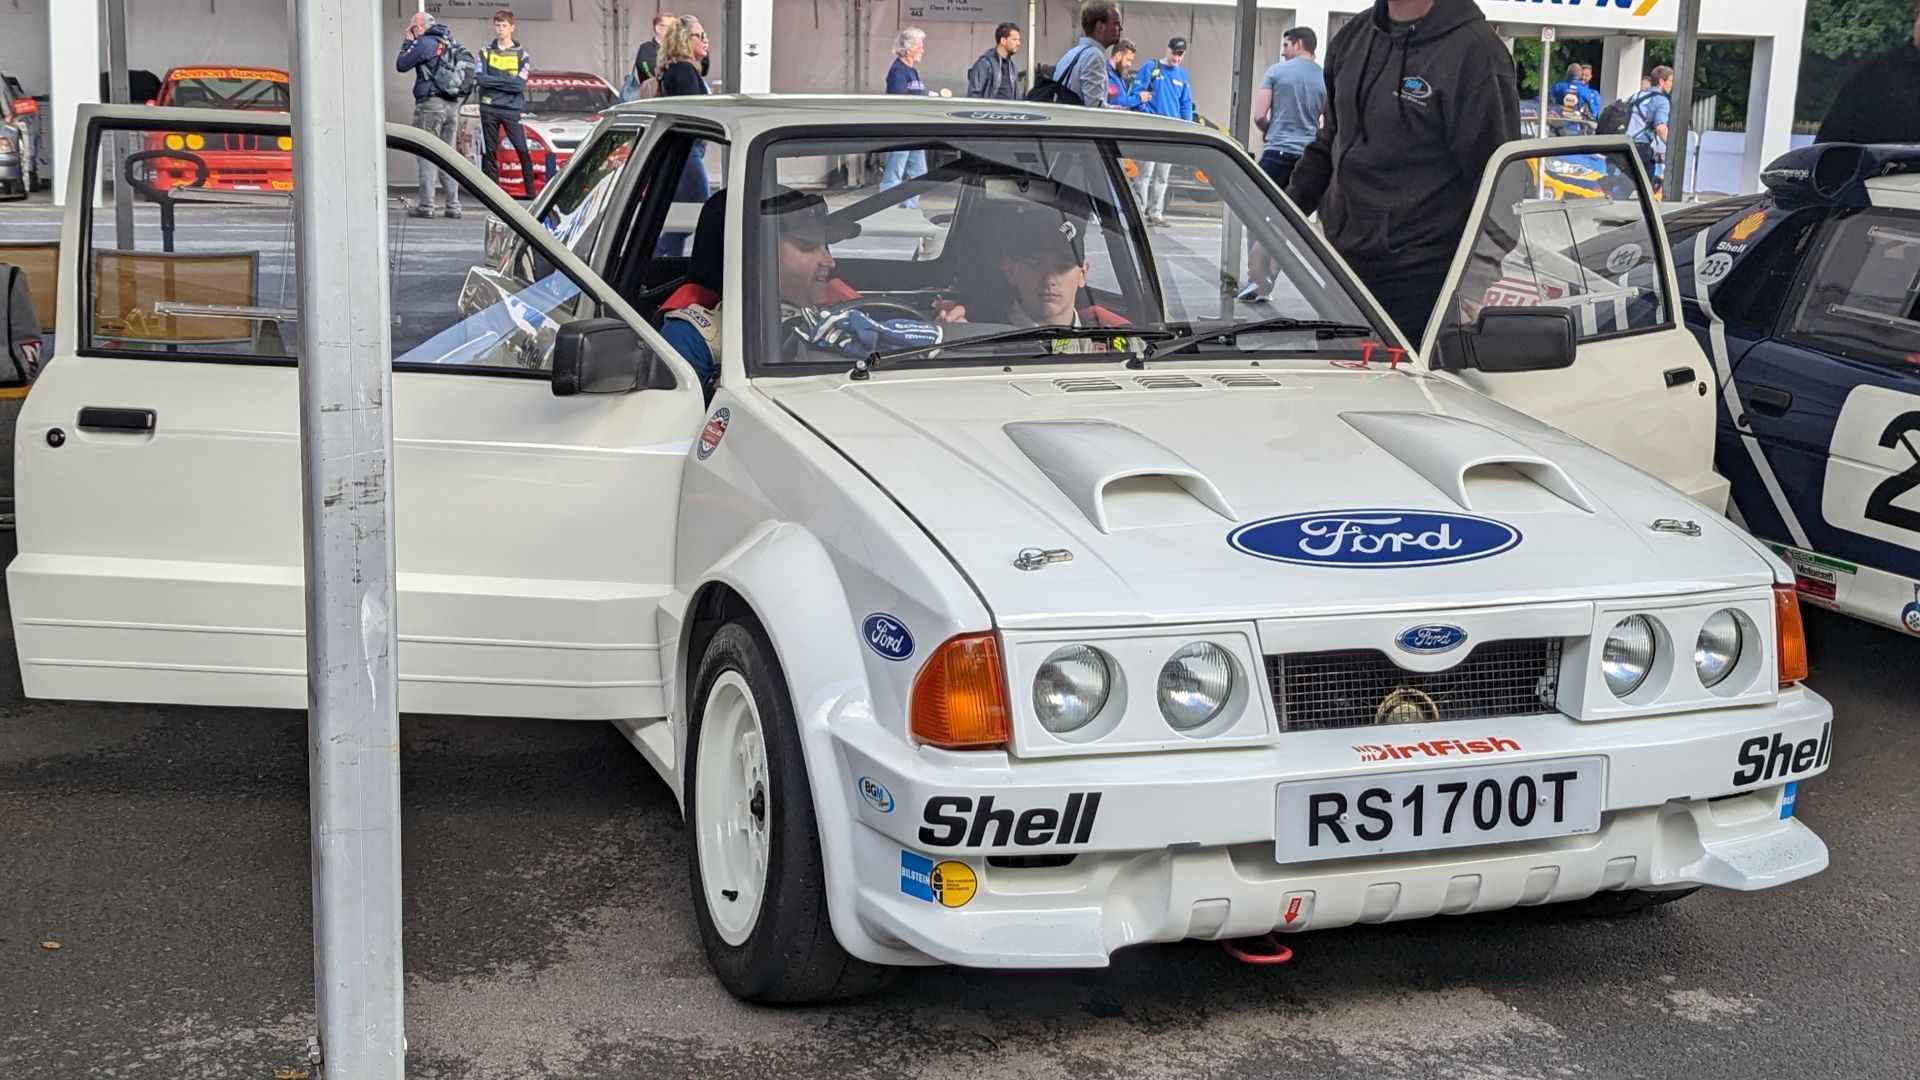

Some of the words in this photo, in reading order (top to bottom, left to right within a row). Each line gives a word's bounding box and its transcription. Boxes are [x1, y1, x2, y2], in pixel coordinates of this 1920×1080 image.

[172, 69, 226, 80] demon
[525, 79, 608, 88] UXHALL
[970, 111, 1030, 121] Ford
[1716, 241, 1747, 253] Shell
[1701, 259, 1729, 277] 235
[1298, 517, 1463, 556] Ford
[1796, 563, 1834, 582] Motorcraft
[871, 618, 904, 653] Ford
[1413, 627, 1452, 646] Ford
[1352, 736, 1522, 762] DirtFish
[1732, 720, 1832, 787] Shell
[864, 779, 884, 801] BGM
[1307, 770, 1578, 848] RS1700T
[918, 792, 1103, 848] Shell
[901, 866, 930, 886] BILSTEIN
